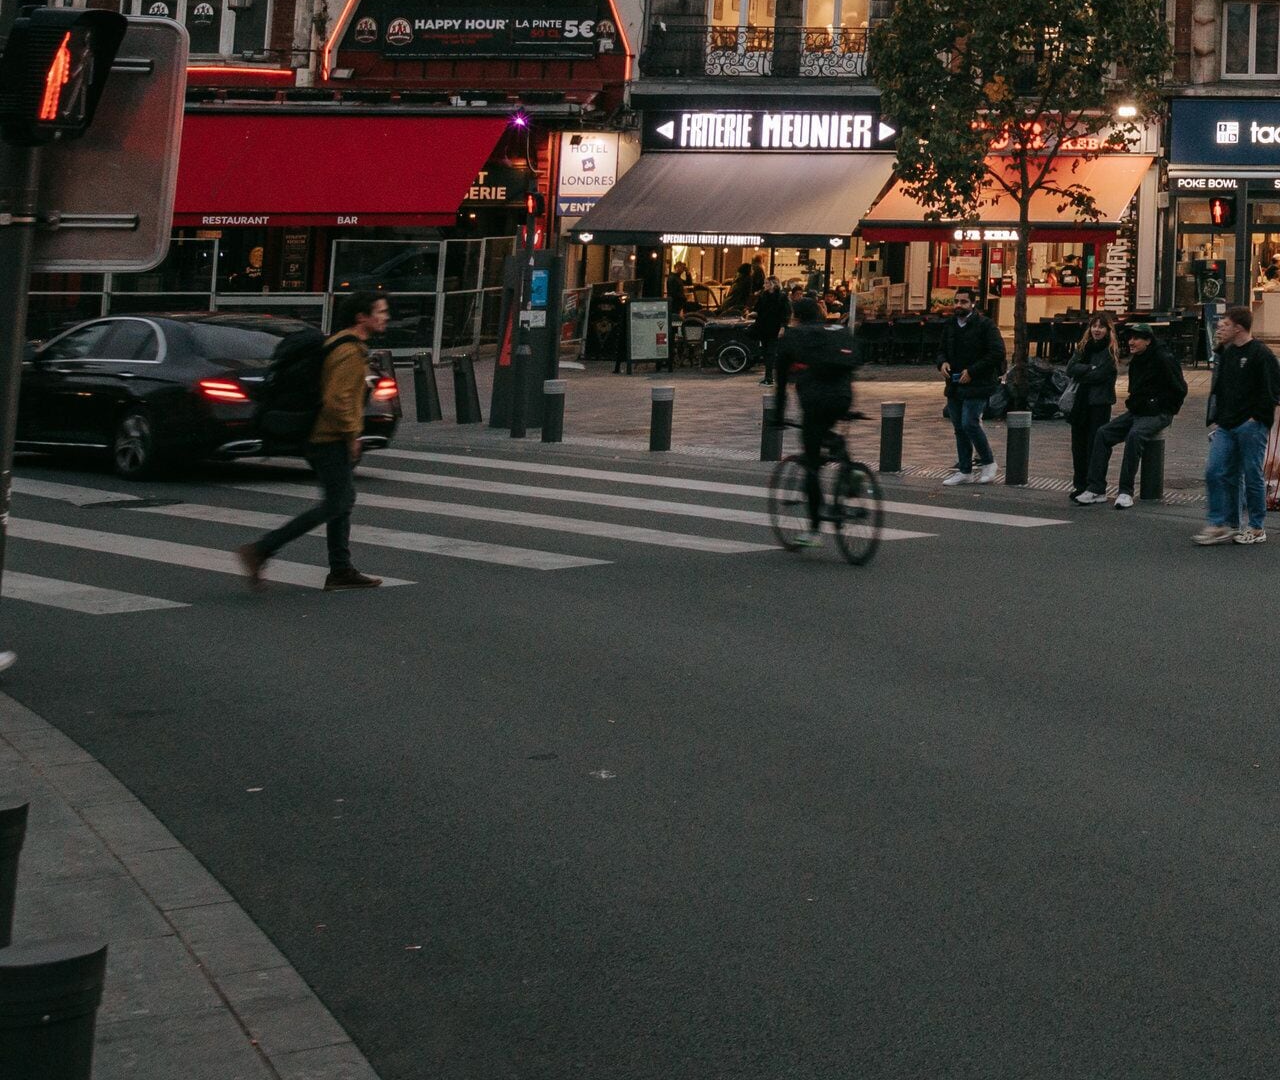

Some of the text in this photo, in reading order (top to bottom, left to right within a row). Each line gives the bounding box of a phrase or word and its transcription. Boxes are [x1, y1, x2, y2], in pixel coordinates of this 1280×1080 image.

[414, 19, 462, 30] HAPPY
[515, 20, 595, 39] LA PINTE 5€
[680, 113, 873, 148] FRITERIE MEUNIER
[571, 144, 608, 154] HOTEL
[561, 176, 615, 186] LONDRES
[1177, 178, 1238, 188] POKE BOWL
[569, 203, 595, 212] ENT
[202, 216, 358, 225] RESTAURANT BAR
[718, 235, 726, 245] ET
[984, 230, 1019, 240] KEBA
